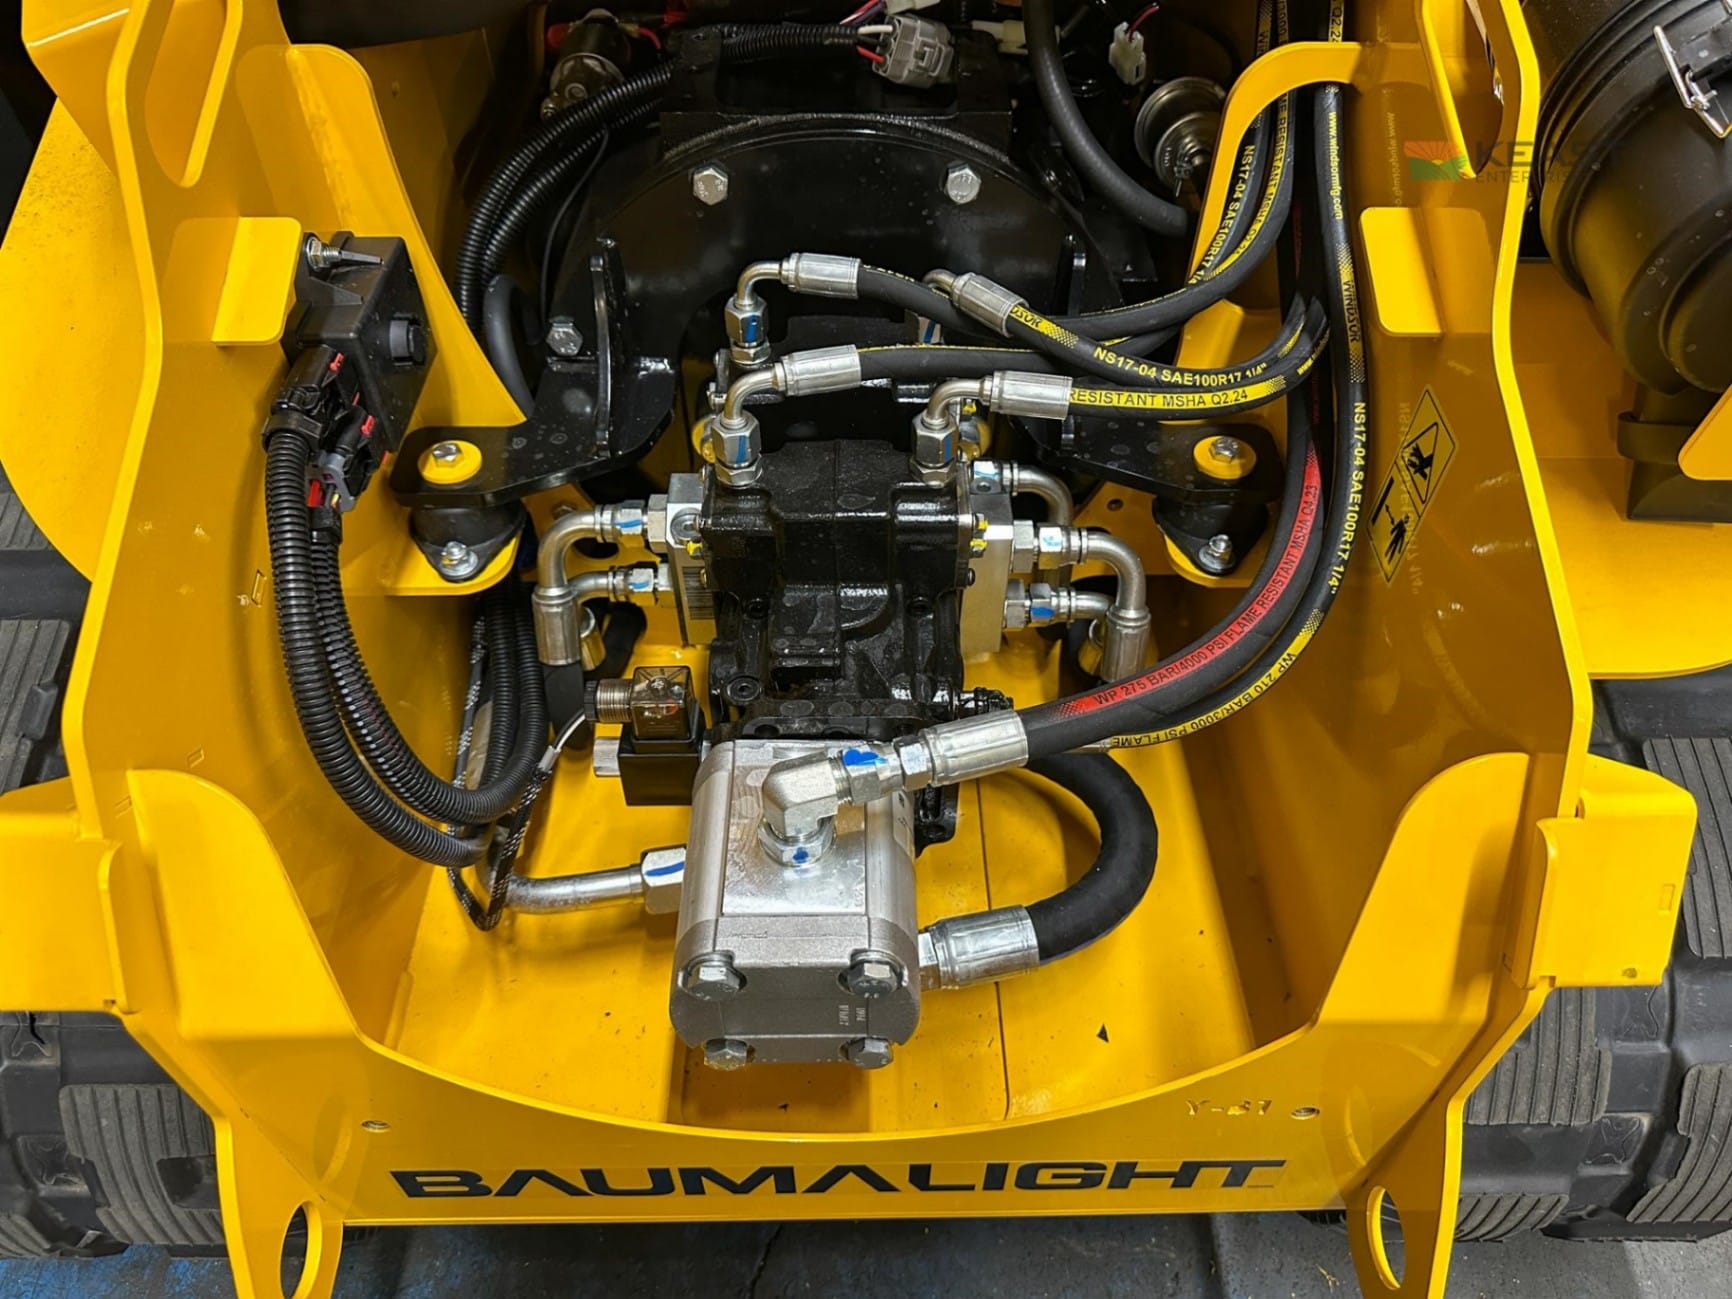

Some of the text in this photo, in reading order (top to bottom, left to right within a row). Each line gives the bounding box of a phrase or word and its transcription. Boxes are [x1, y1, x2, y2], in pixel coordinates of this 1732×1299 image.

[1233, 145, 1256, 199] NS17-04
[1327, 111, 1343, 220] www.windsormfg.com
[1202, 201, 1240, 268] SAE100R17
[1342, 280, 1361, 343] WINDSOR
[1069, 389, 1249, 408] RESISTANT MSHA Q2.24
[1093, 346, 1158, 379] NS17-04
[1160, 369, 1243, 387] SAE100R17
[1353, 401, 1367, 467] NS17-04
[1338, 470, 1366, 561] SAE100R17
[1094, 689, 1118, 706] WP
[1120, 681, 1147, 696] 275
[1149, 650, 1208, 687] BAR/4000
[1207, 636, 1229, 656] PSI
[1224, 607, 1263, 641] FLAME
[1255, 552, 1300, 610] RESISTANT
[1291, 517, 1310, 551] MSHA
[1111, 651, 1297, 747] WP 210 BAR/3000 PSI FLAME
[390, 1159, 1287, 1198] BAUMALIGHT
